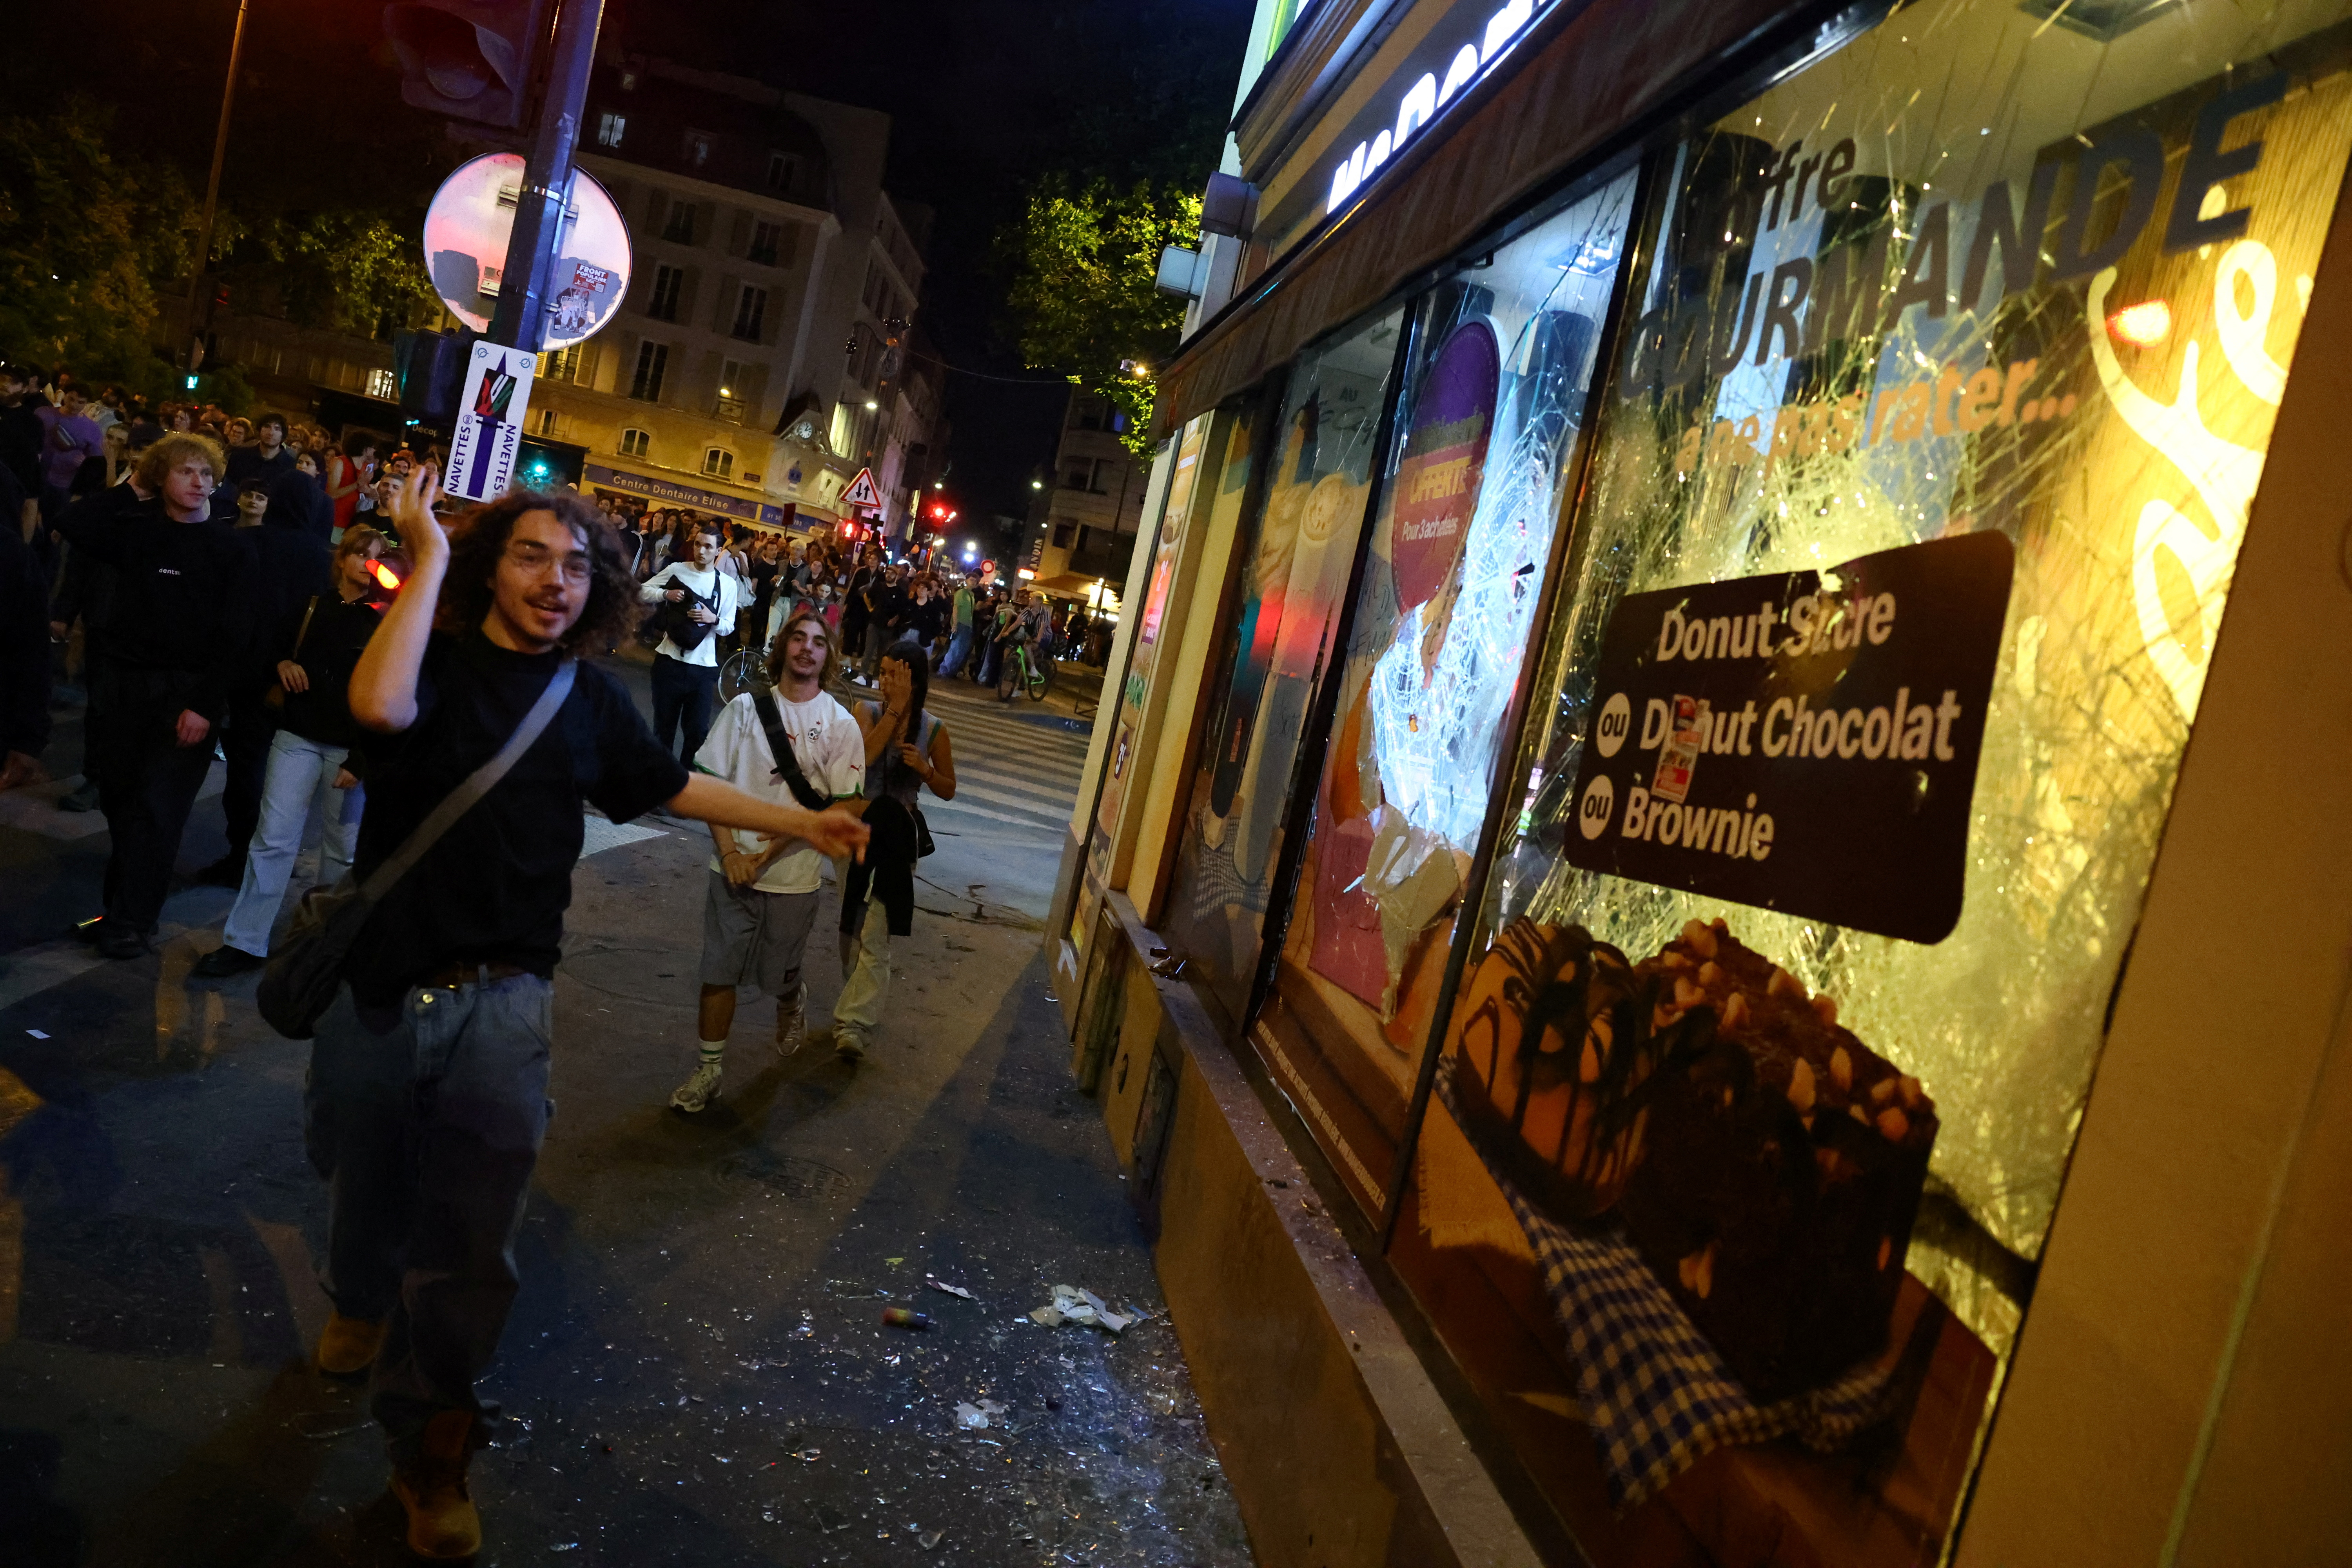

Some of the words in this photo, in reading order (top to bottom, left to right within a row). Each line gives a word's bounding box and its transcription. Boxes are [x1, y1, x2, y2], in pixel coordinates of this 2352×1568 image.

[576, 270, 607, 283] POPULAIRE
[579, 265, 606, 278] FRONT
[448, 426, 470, 493] NAVETTES
[494, 425, 517, 491] NAVETTES
[613, 476, 649, 491] Centre
[653, 485, 698, 502] Dentaire
[702, 495, 729, 509] Elise
[1402, 521, 1420, 542] Pour
[1418, 518, 1426, 540] 3
[1657, 601, 1778, 661] Donut
[1640, 699, 1758, 756] Dnut
[1762, 687, 1962, 761] Chocolat
[1621, 786, 1774, 861] Brownie
